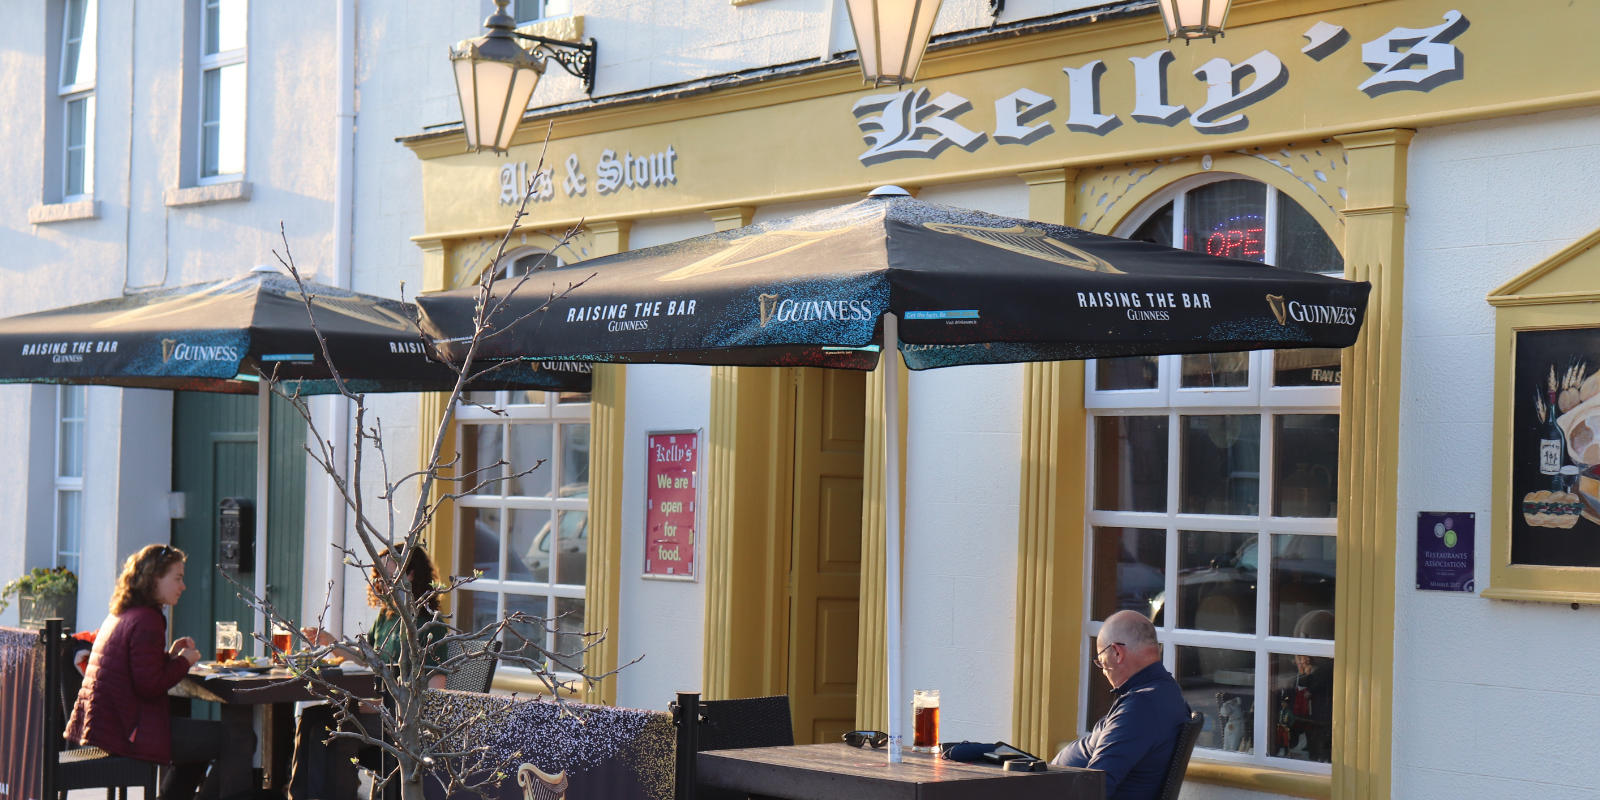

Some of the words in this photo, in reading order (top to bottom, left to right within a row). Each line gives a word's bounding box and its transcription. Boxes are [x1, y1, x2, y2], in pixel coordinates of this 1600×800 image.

[851, 10, 1470, 167] Kelly's
[500, 160, 554, 205] Ales
[563, 153, 587, 197] &
[596, 143, 678, 196] Stout
[1207, 228, 1265, 256] OPE
[1077, 291, 1142, 308] RAISING
[1146, 293, 1177, 308] THE
[1182, 293, 1212, 309] BAR
[566, 303, 628, 323] RAISING
[634, 301, 663, 318] THE
[667, 299, 697, 316] BAR
[777, 299, 873, 322] GUINNESS
[1127, 308, 1170, 321] GUINNESS
[1288, 300, 1357, 326] GUINNESS
[608, 320, 649, 332] GUINNESS
[22, 342, 68, 356] RAISING
[71, 341, 93, 353] THE
[96, 341, 119, 353] BAR
[174, 343, 239, 362] GUINNESS
[389, 341, 426, 354] RAISI
[541, 360, 593, 374] GUINNES
[656, 444, 693, 463] Kelly's
[657, 474, 672, 489] We
[674, 477, 689, 489] are
[661, 501, 683, 516] open
[664, 522, 678, 537] for
[658, 546, 682, 561] food.
